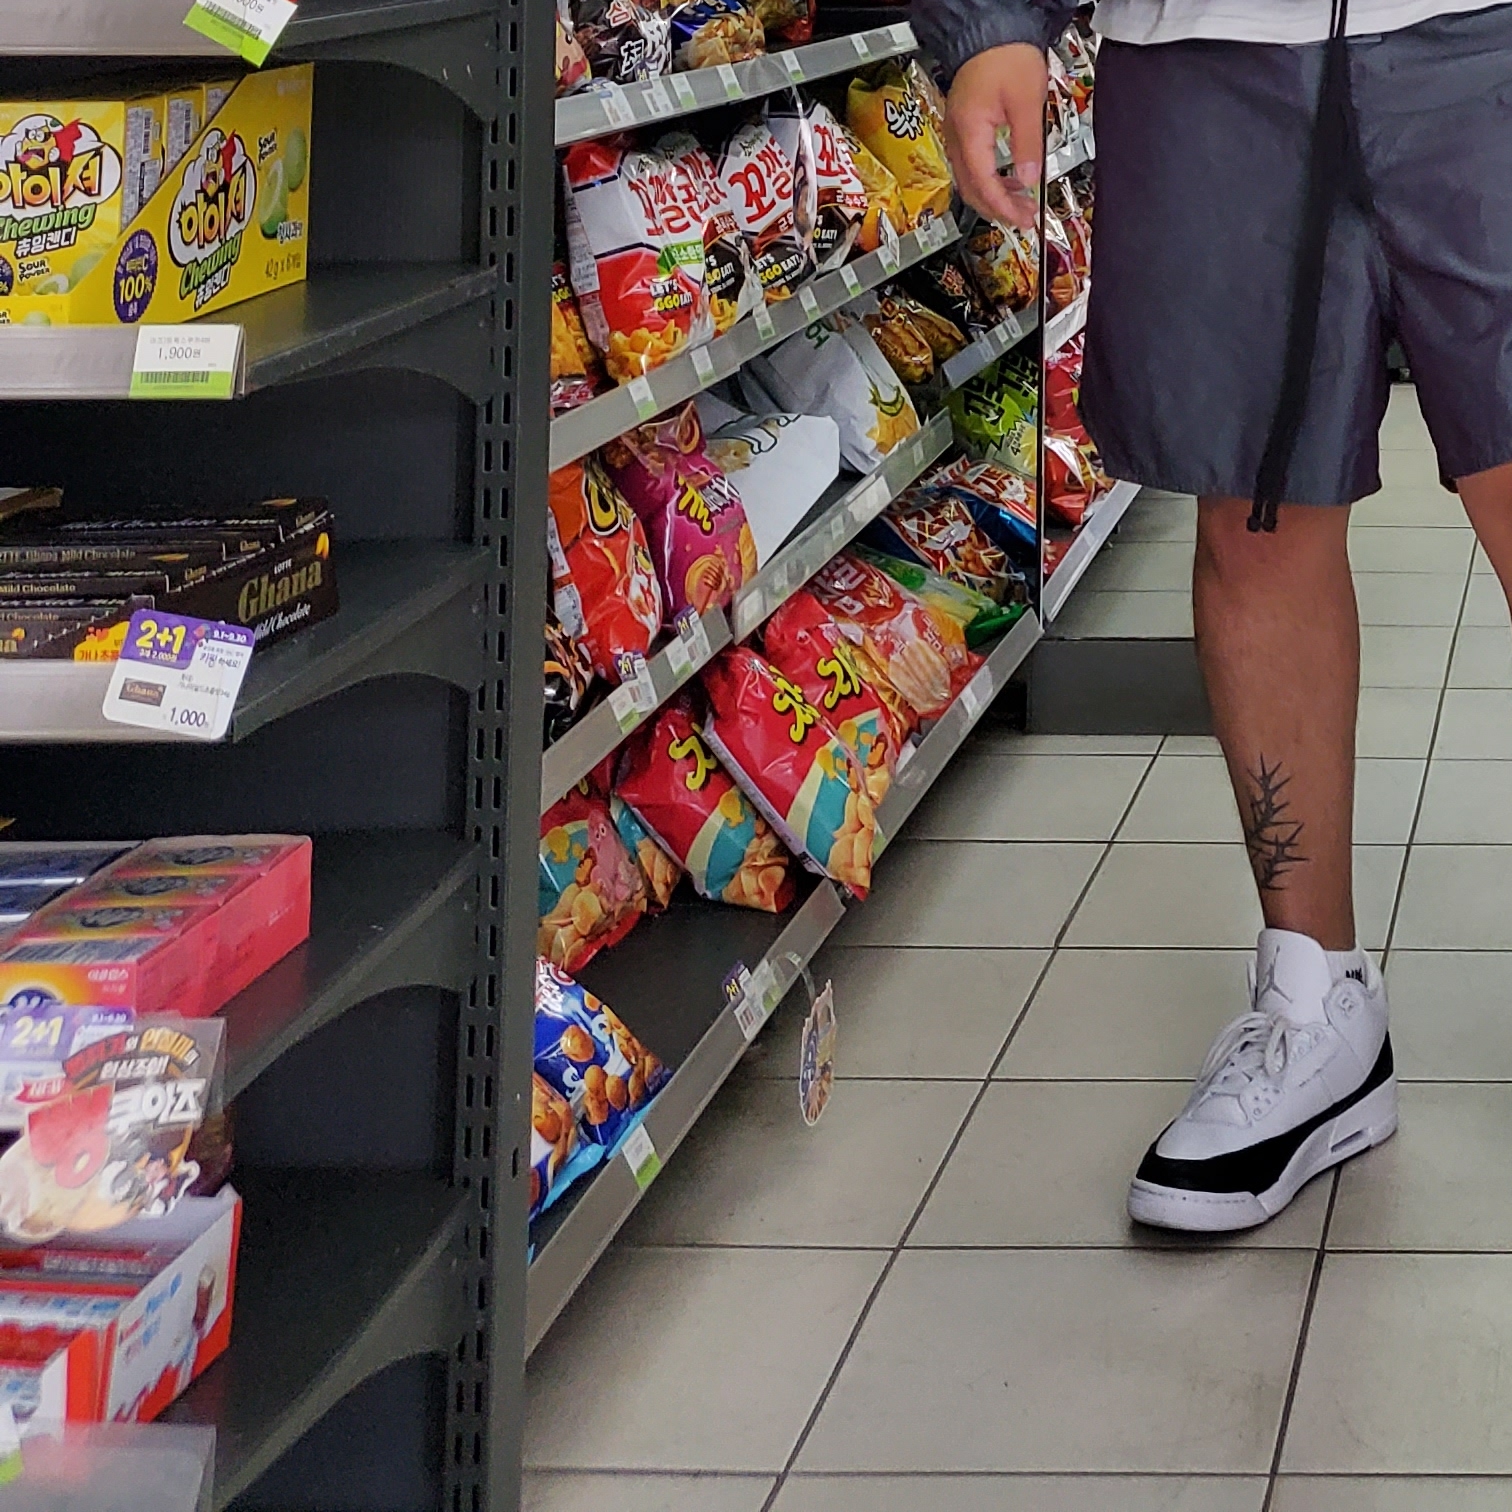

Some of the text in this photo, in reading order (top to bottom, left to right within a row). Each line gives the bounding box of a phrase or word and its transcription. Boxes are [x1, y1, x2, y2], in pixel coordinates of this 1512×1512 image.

[178, 167, 248, 250] 아이셔
[15, 227, 77, 260] 츄잉캔디
[18, 260, 48, 272] SOUR
[180, 229, 243, 300] Chewing
[119, 277, 153, 304] 100%
[651, 277, 678, 294] LET'S
[654, 294, 680, 312] GGO
[157, 347, 201, 361] 1,900원
[273, 557, 293, 576] LOTTE
[237, 560, 322, 624] Ghana
[270, 602, 311, 635] Chocolate
[135, 619, 187, 656] 2+1
[10, 1015, 65, 1049] 2+1
